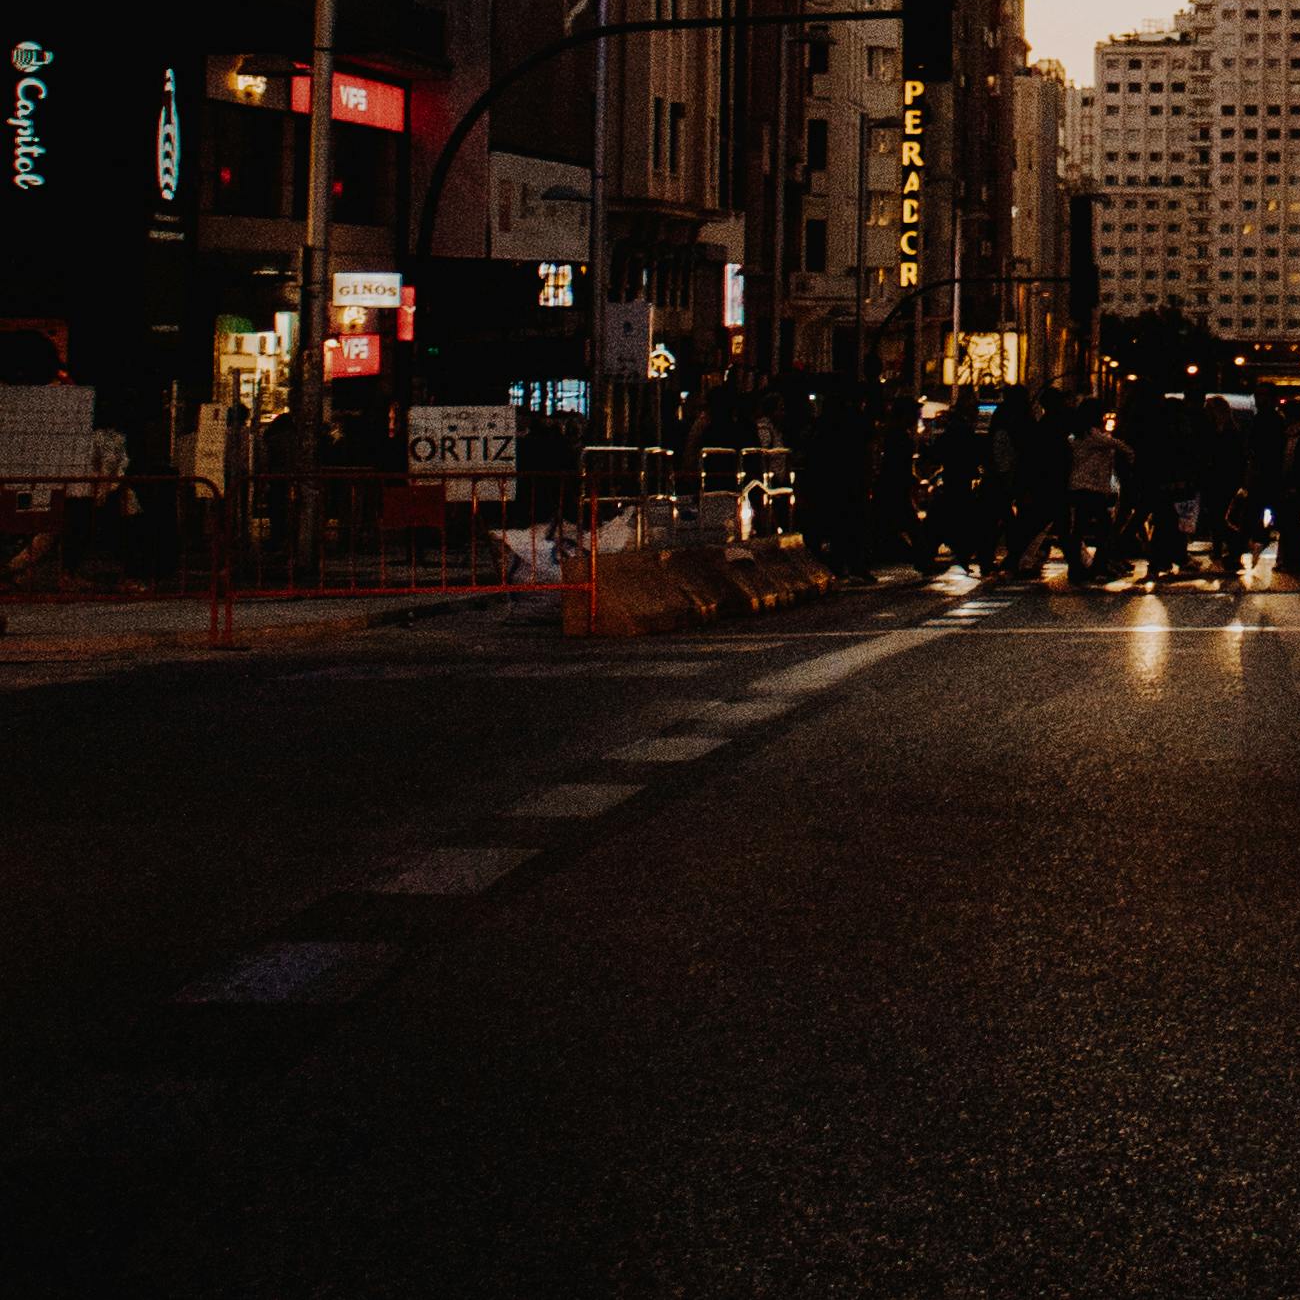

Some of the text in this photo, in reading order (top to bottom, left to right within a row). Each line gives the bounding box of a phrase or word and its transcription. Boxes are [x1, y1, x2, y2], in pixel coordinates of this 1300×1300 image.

[7, 77, 48, 190] Capitol
[338, 281, 397, 297] GINOS
[409, 435, 514, 462] ORTIZ
